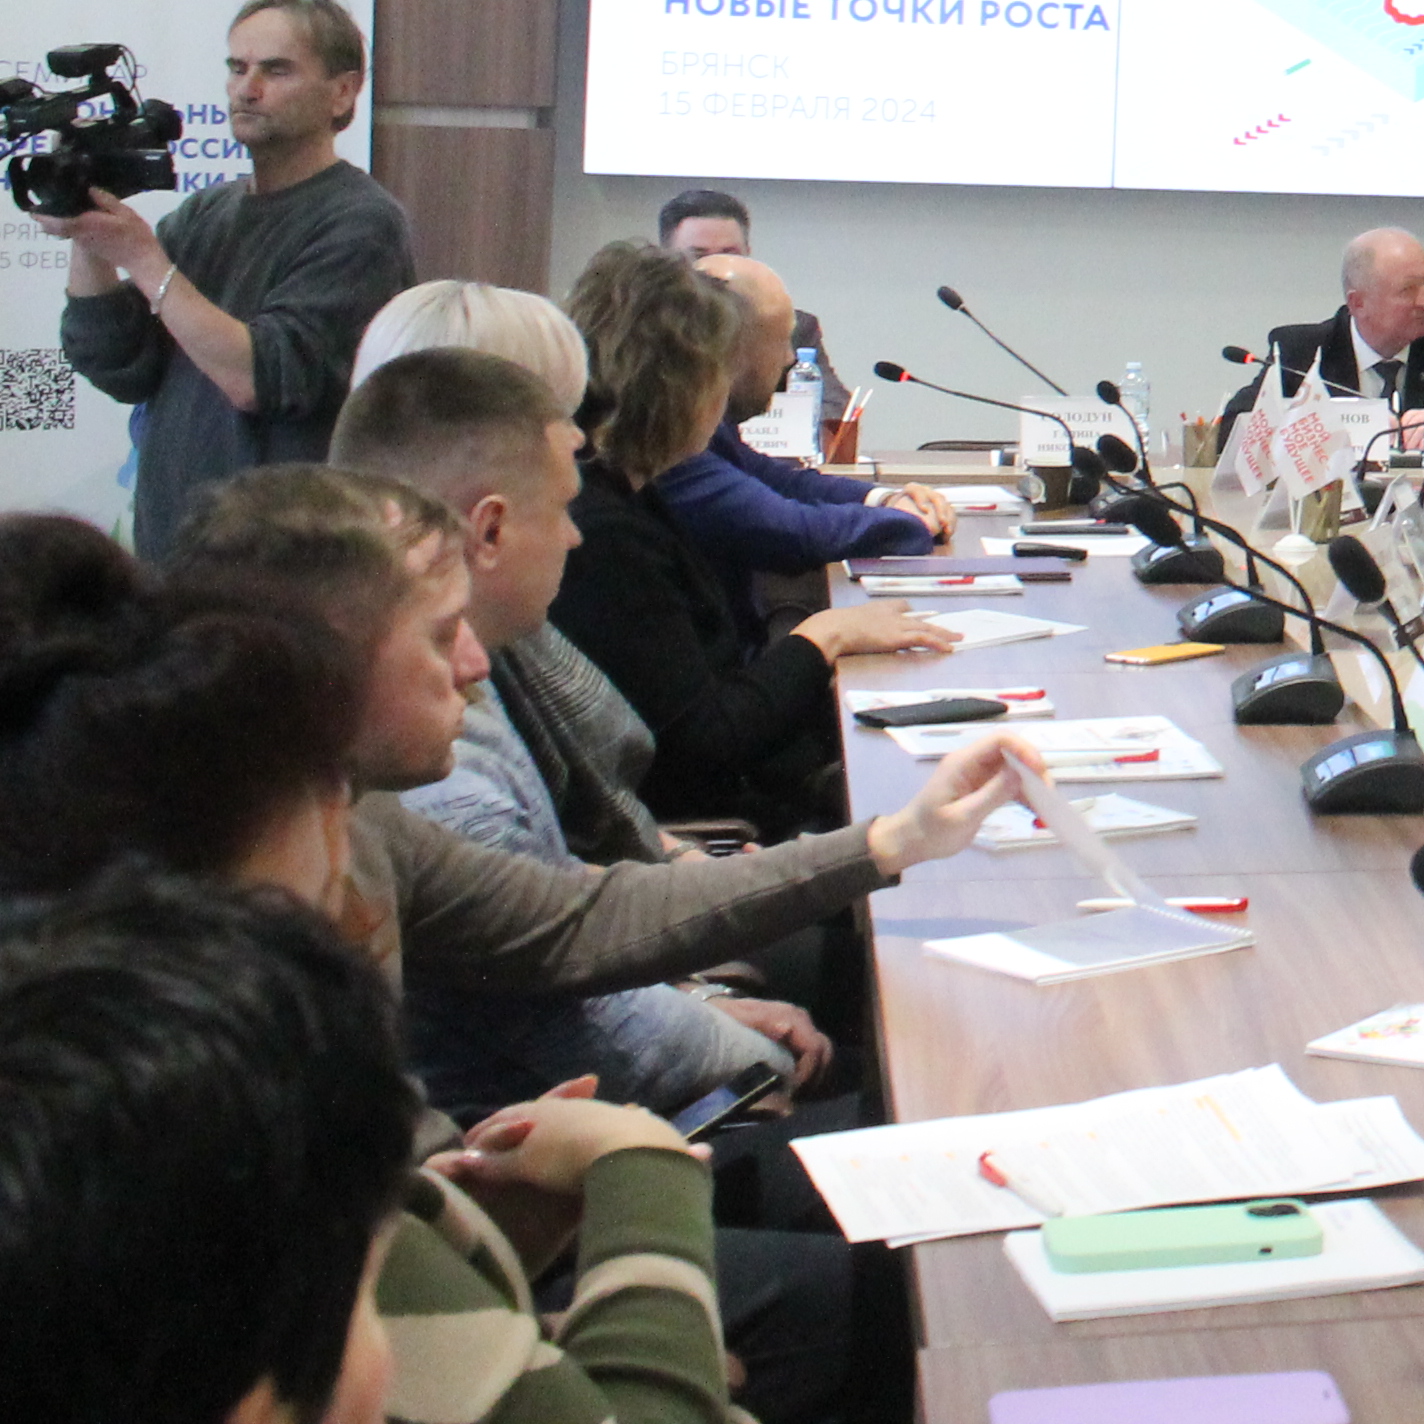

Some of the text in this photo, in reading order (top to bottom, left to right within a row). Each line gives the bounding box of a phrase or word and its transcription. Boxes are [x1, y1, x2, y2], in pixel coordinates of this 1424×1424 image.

[980, 0, 1111, 31] РОСТА
[661, 50, 791, 79] БРЯНСК
[658, 90, 938, 124] 15 ФЕВРАЛЯ 2024
[1307, 412, 1332, 443] МОЙ
